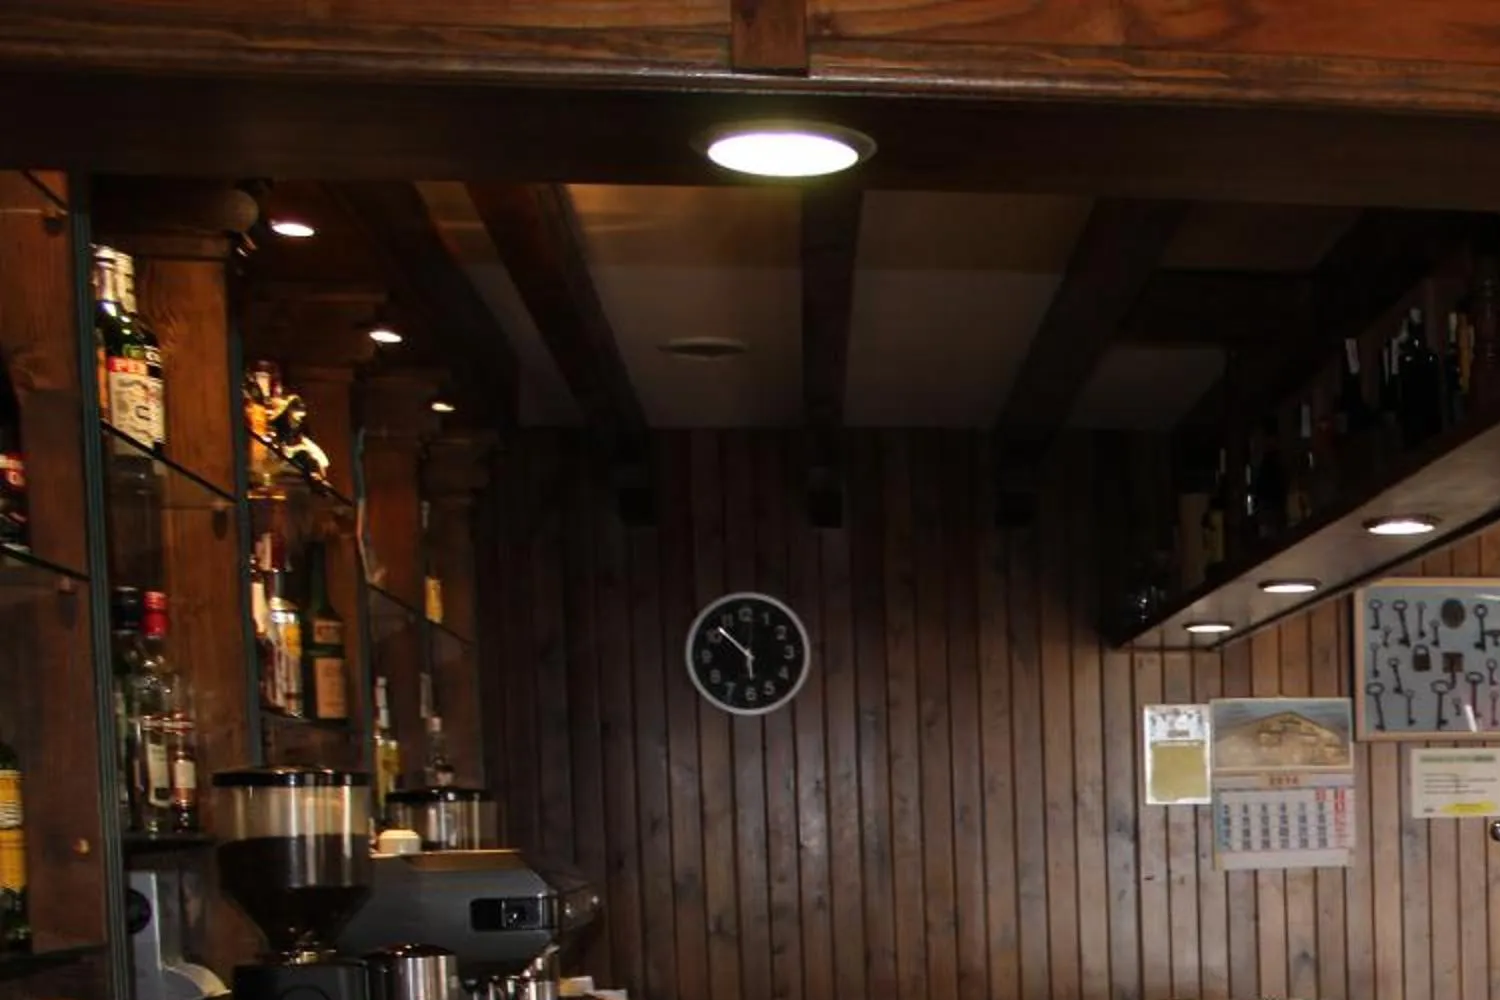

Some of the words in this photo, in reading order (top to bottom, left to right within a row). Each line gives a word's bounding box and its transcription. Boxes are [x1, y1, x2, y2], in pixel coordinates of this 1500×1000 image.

[762, 612, 770, 625] 1
[776, 625, 788, 640] 2
[783, 645, 795, 660] 3
[778, 665, 789, 680] 4
[725, 682, 736, 702] 7
[744, 686, 757, 701] 6
[763, 680, 776, 695] 5
